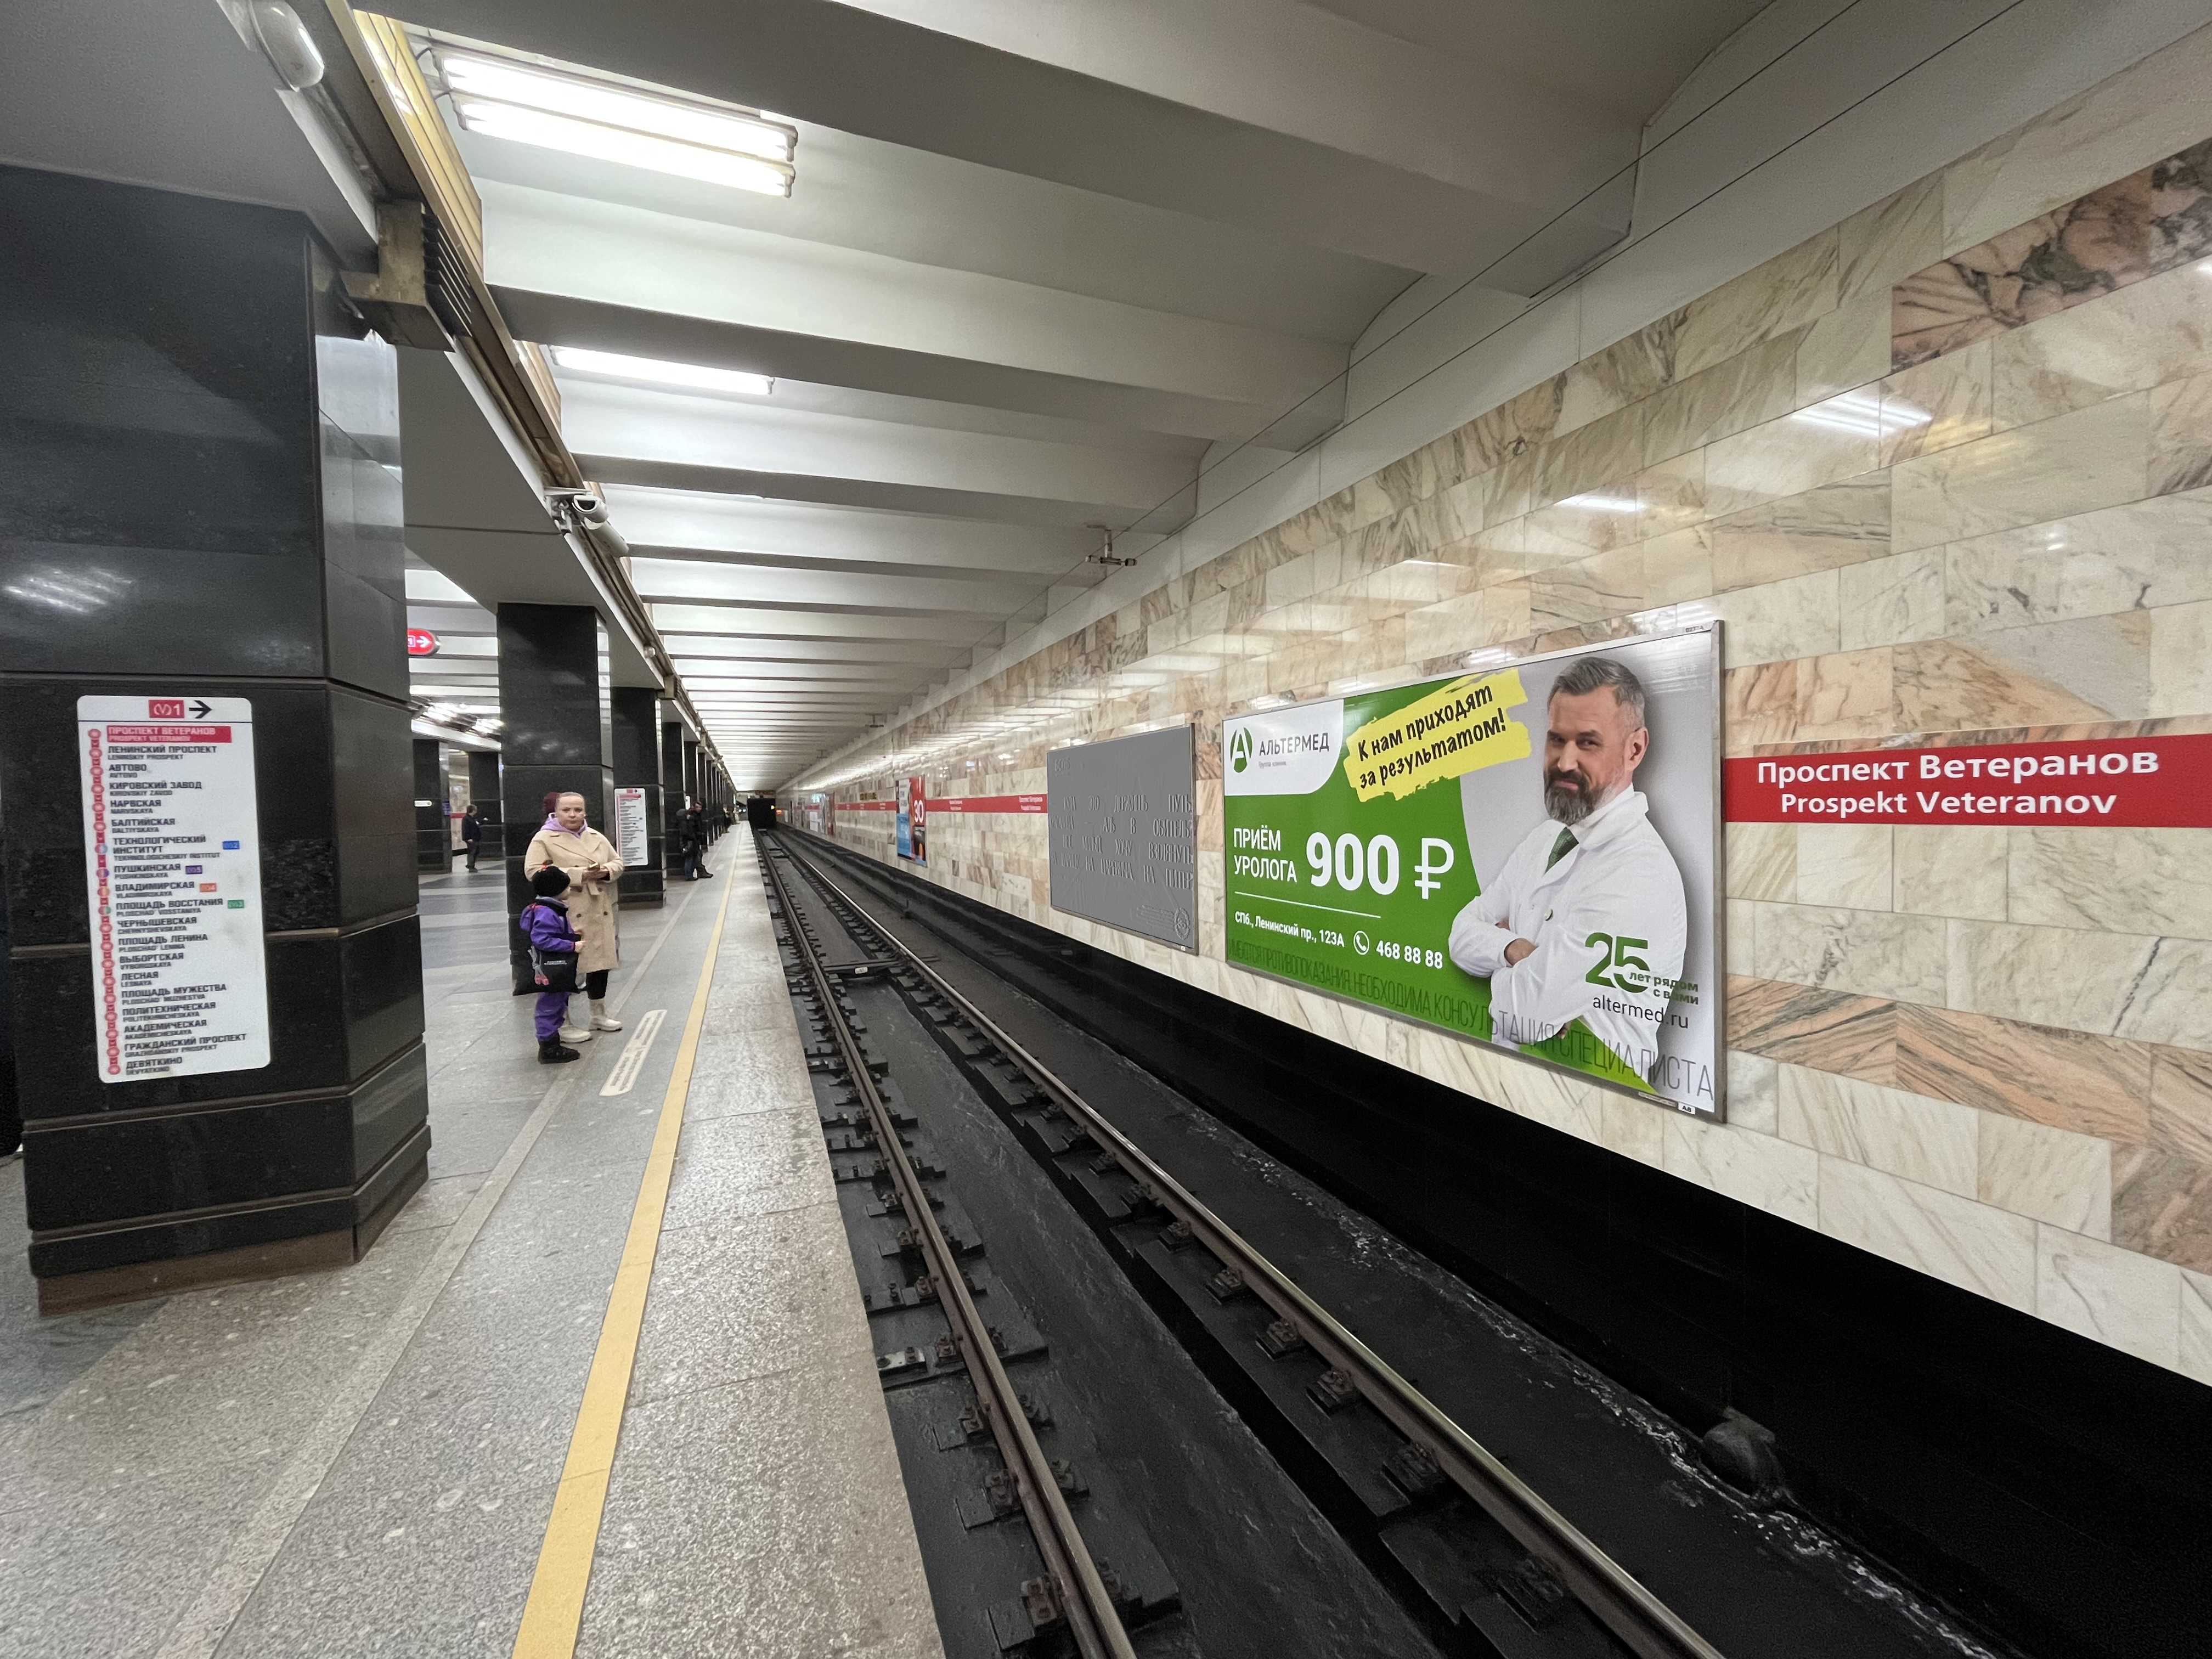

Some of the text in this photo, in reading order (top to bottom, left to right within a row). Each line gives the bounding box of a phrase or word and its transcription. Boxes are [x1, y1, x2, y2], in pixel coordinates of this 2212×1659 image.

[161, 727, 216, 735] ВЕТЕРАНОВ
[1358, 685, 1493, 761] К нам приходят
[109, 745, 166, 754] ЛЕНИНСКИЙ
[1259, 732, 1329, 756] АЛЬТЕРМЕД
[1360, 708, 1506, 788] за результатом!
[1758, 752, 2159, 788] Проспект Ветеранов
[109, 780, 167, 789] КИРОВСКИЙ
[913, 800, 924, 823] 30
[1781, 791, 2118, 818] Prospekt Veteranov
[111, 817, 175, 826] БАЛТИЙСКАЯ
[114, 834, 206, 845] ТЕХНОЛОГИЧЕСКИЙ
[1233, 825, 1281, 851] ПРИЁМ
[114, 864, 181, 873] ПУШКИНСКАЯ
[1233, 855, 1297, 883] УРОЛОГА
[1306, 832, 1400, 895] 900
[115, 882, 195, 891] ВЛАДИМИРСКАЯ
[116, 898, 223, 910] ПЛОЩАДЬ ВОССТАНИЯ
[117, 917, 197, 927] ЧЕРНЫШЕВСКАЯ
[119, 934, 208, 945] ПЛОЩАДЬ ЛЕНИНА
[1255, 915, 1299, 938] Ленинский
[1300, 928, 1317, 943] пр.,
[1319, 929, 1345, 948] 123А
[120, 952, 184, 963] ВЫБОРГСКАЯ
[1376, 940, 1443, 969] 468 88 88
[1585, 932, 1651, 994] 25
[121, 972, 159, 980] ЛЕСНАЯ
[1629, 972, 1699, 992] лет рядом
[121, 984, 227, 997] ПЛОЩАДЬ МУЖЕСТВА
[1653, 989, 1699, 1005] с вами
[122, 1002, 216, 1015] ПОЛИТЕХНИЧЕСКАЯ
[1593, 994, 1689, 1029] altermed.ru
[124, 1019, 207, 1032] АКАДЕМИЧЕСКАЯ
[125, 1034, 247, 1051] ГРАЖДАНСКИЙ ПРОСПЕКТ
[1353, 973, 1433, 1015] НЕОБХОДИМА
[1559, 1027, 1714, 1101] СПЕЦИАЛИСТА
[126, 1057, 182, 1069] ДЕВЯТКИНО
